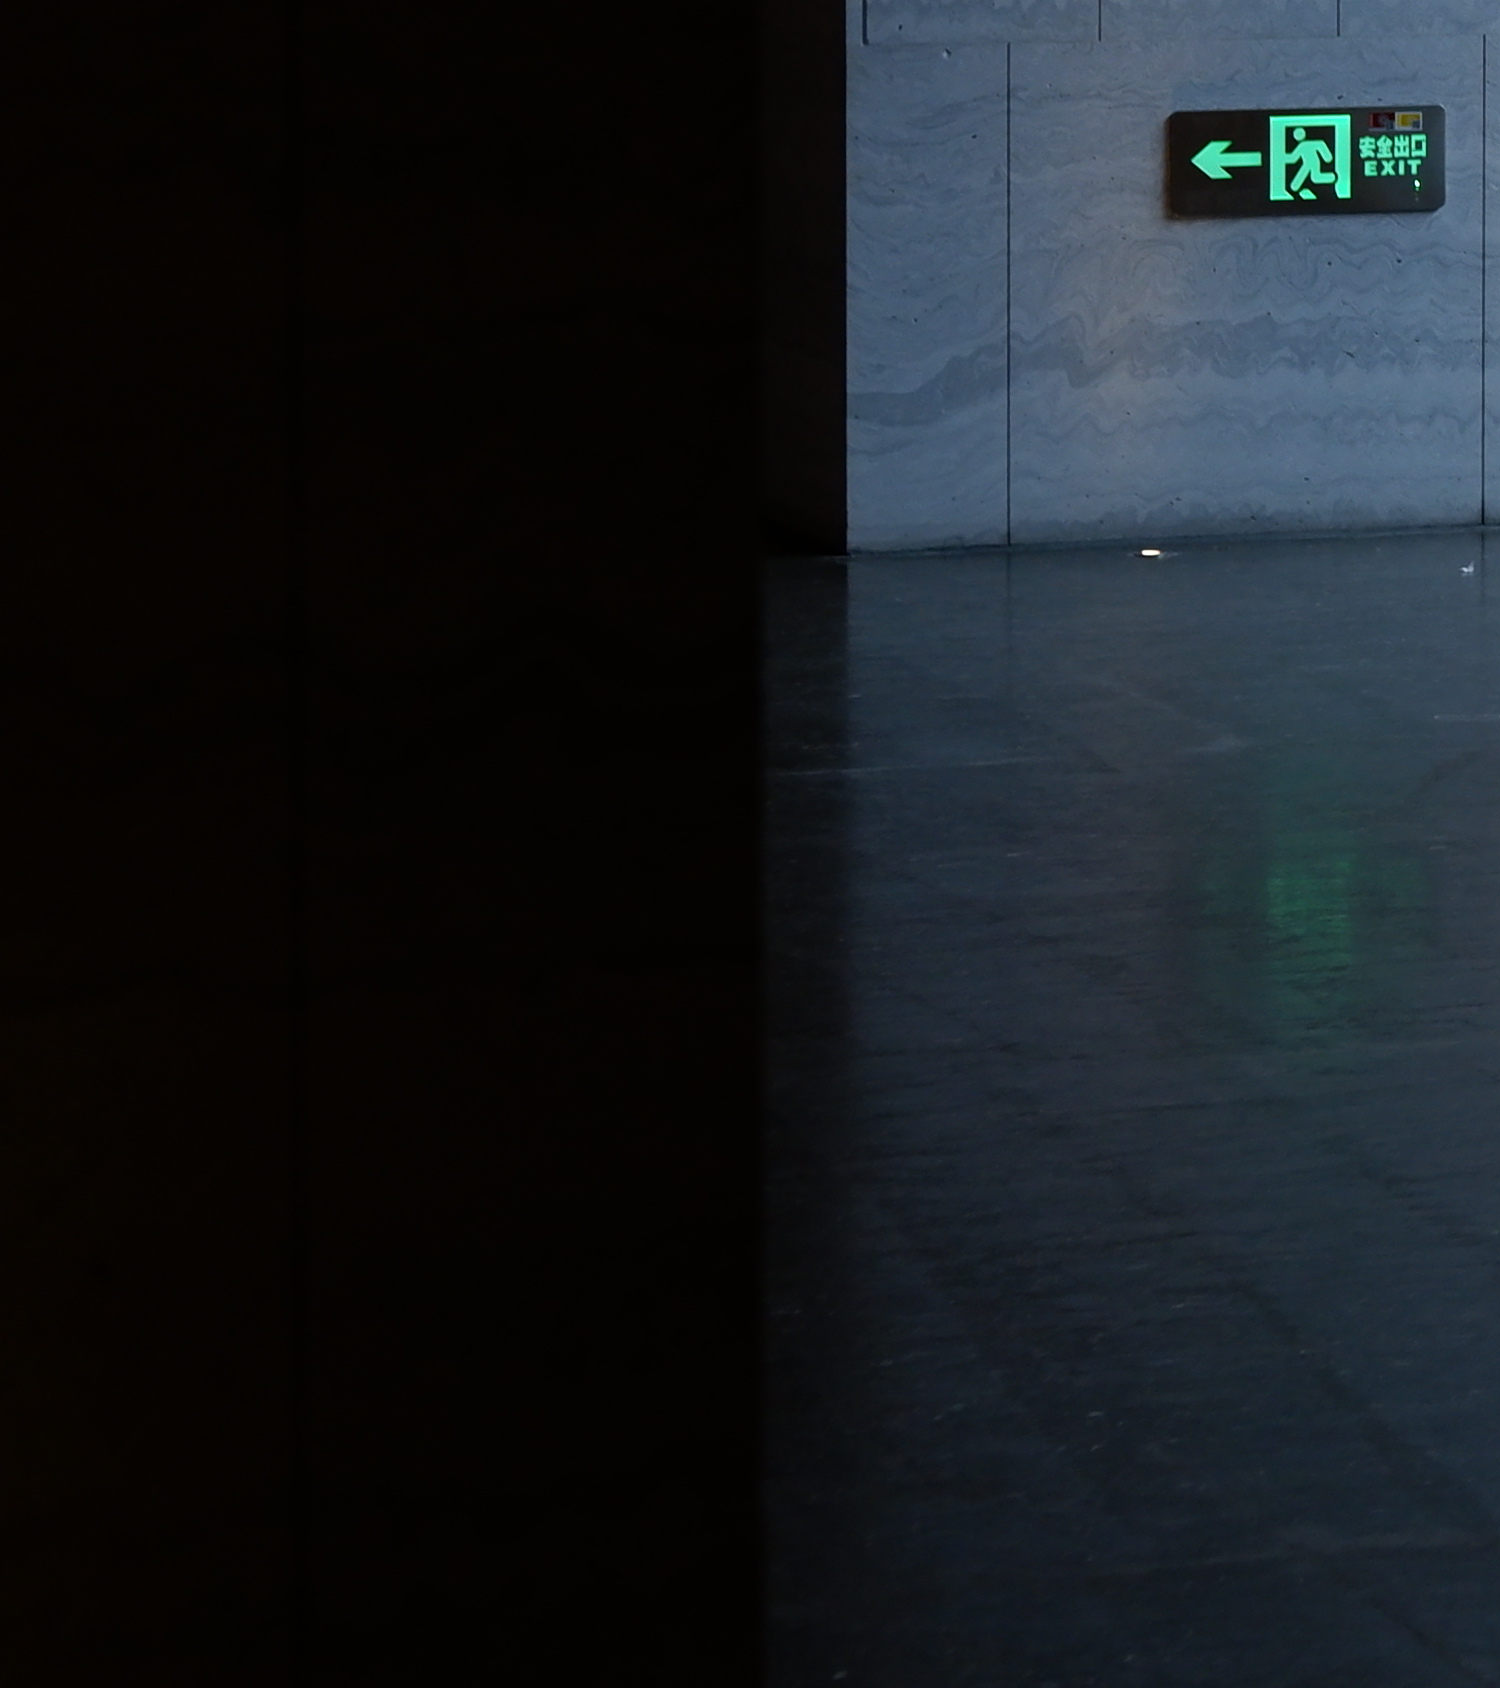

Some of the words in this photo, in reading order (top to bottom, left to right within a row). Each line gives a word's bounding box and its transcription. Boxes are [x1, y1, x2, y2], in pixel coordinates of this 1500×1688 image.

[1359, 134, 1427, 158] 安全出口
[1364, 159, 1422, 177] EXIT
